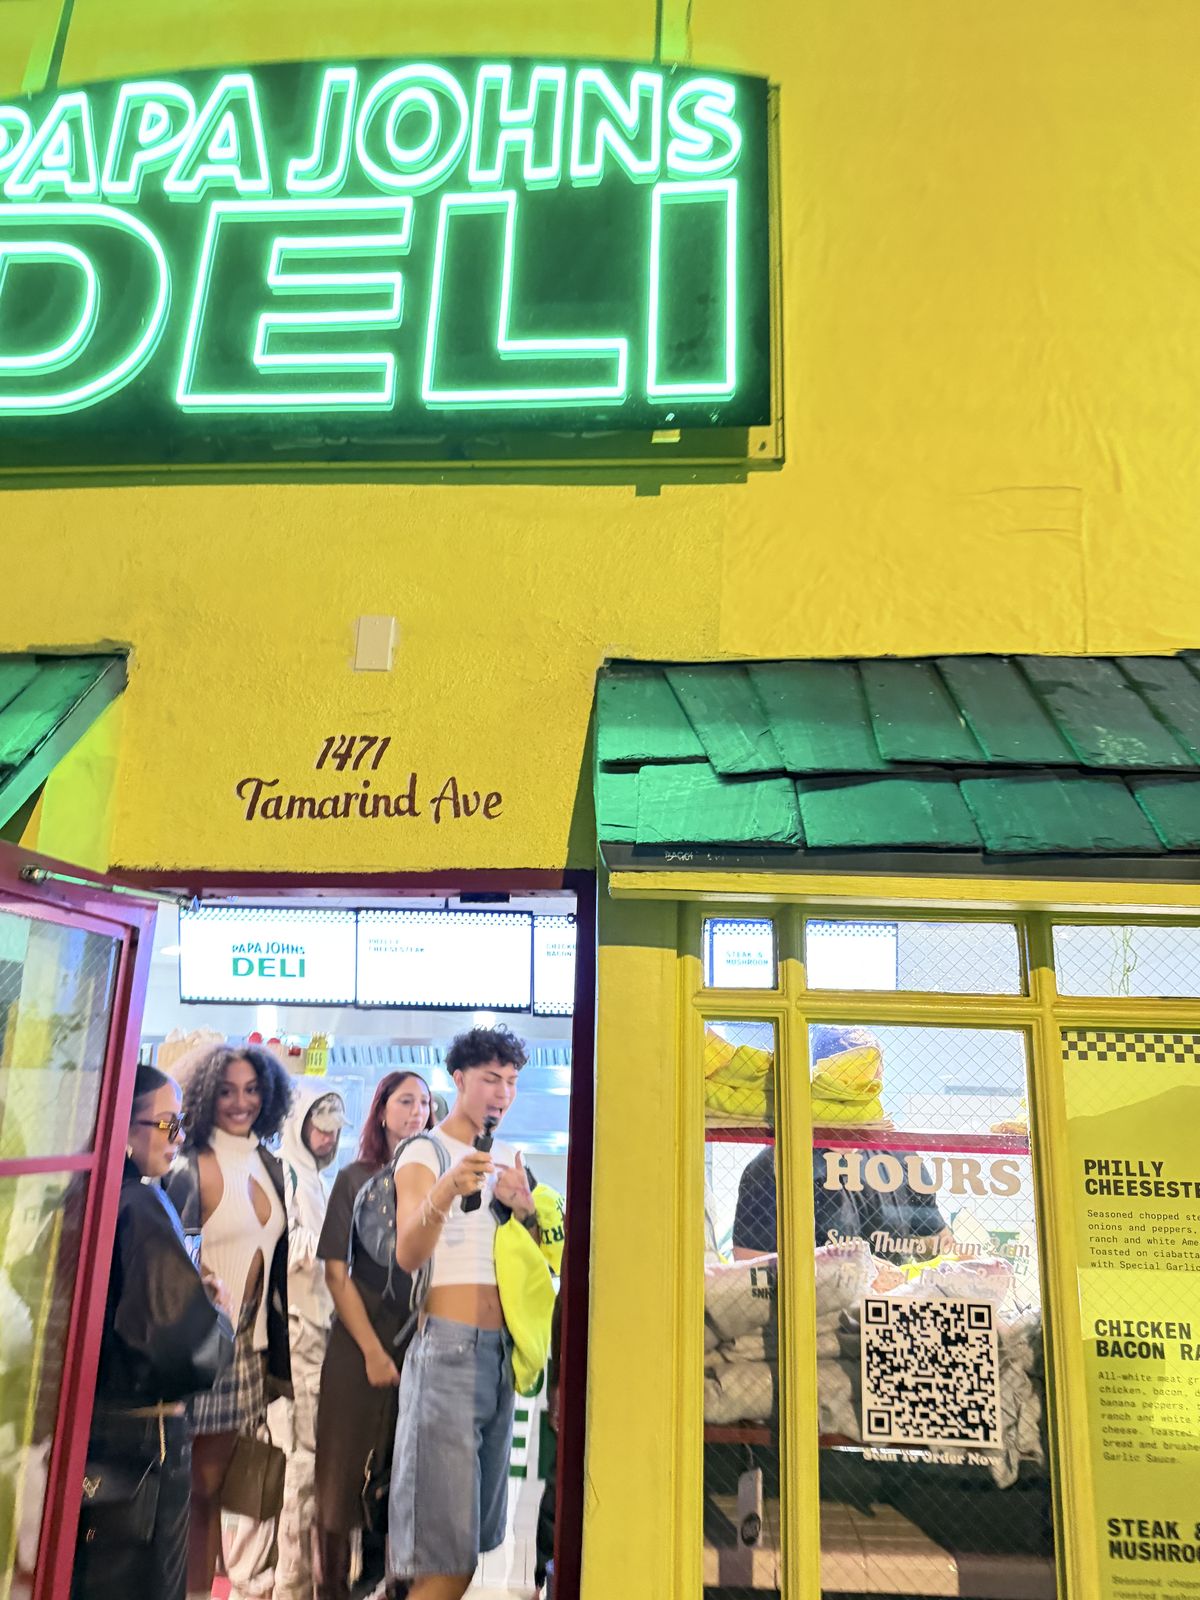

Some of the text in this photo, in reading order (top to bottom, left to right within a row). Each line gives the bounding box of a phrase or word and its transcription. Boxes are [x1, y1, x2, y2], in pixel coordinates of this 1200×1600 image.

[286, 62, 743, 196] JOHNS
[0, 179, 738, 414] DELI
[316, 735, 391, 771] 1471
[236, 773, 503, 823] Tamarind Ave
[232, 942, 305, 954] PAPA JOHNS
[232, 957, 305, 978] DELI
[822, 1152, 1022, 1197] HOURS
[1084, 1159, 1164, 1177] PHILLY
[1087, 1209, 1133, 1218] Seasoned
[1140, 1212, 1180, 1221] chopped
[1088, 1222, 1122, 1231] onions
[1128, 1224, 1146, 1232] and
[870, 1231, 927, 1253] Thurs
[1089, 1235, 1118, 1243] ranch
[1124, 1236, 1141, 1244] and
[1147, 1237, 1176, 1245] white
[1089, 1247, 1130, 1256] Toasted
[1090, 1259, 1114, 1268] with
[1120, 1261, 1160, 1270] Special
[1095, 1319, 1191, 1340] CHICKEN
[1096, 1340, 1165, 1360] BACON
[1098, 1371, 1152, 1382] All-white
[1157, 1374, 1182, 1383] meat
[1100, 1398, 1136, 1408] banana
[1101, 1412, 1131, 1421] ranch
[1137, 1414, 1154, 1422] and
[1103, 1439, 1133, 1448] bread
[1139, 1440, 1157, 1449] and
[921, 1450, 965, 1465] Order
[967, 1451, 1002, 1466] Now
[1103, 1451, 1140, 1462] Garlic
[1107, 1518, 1181, 1540] STEAK
